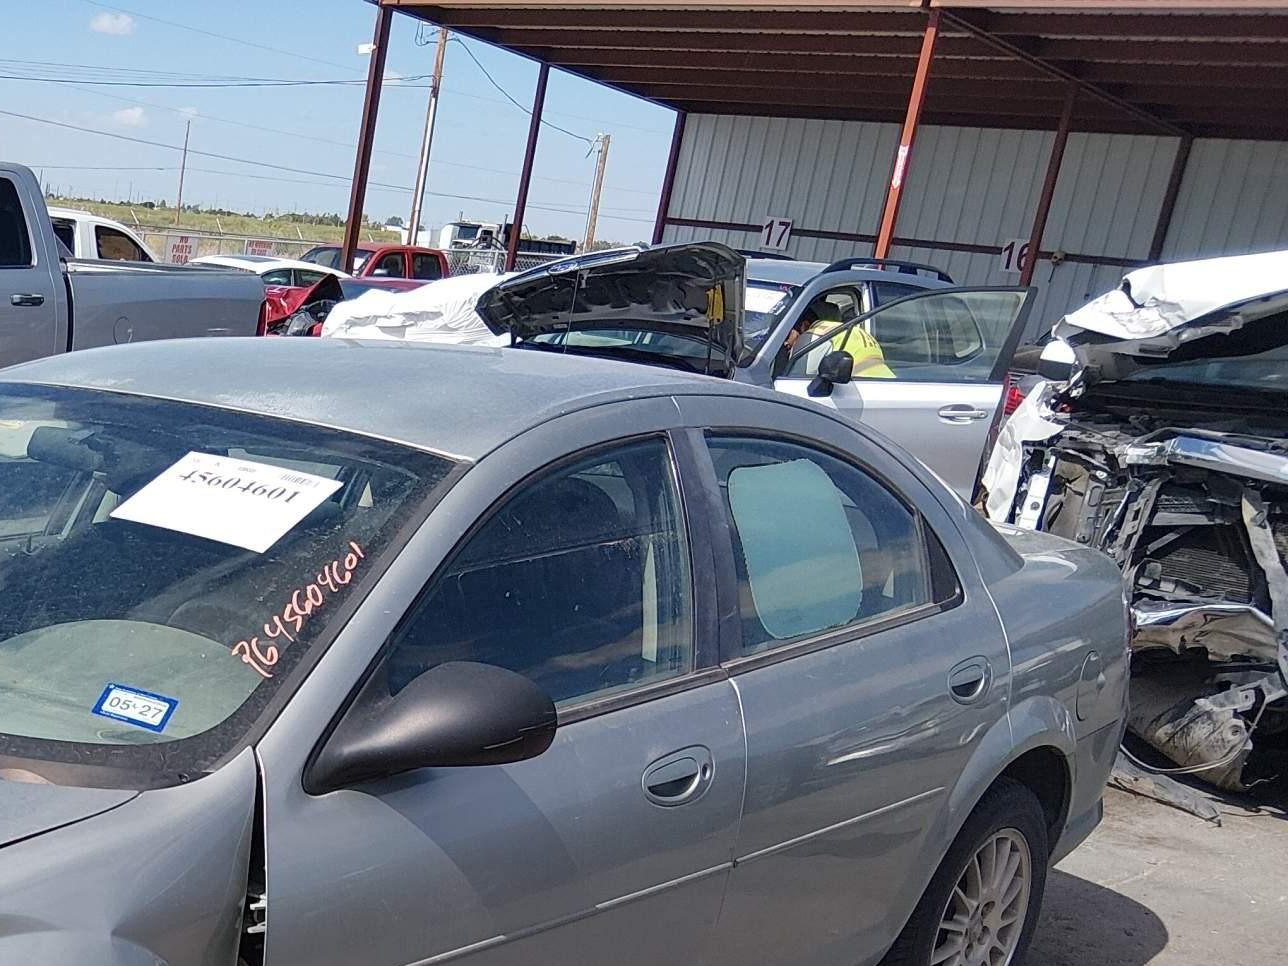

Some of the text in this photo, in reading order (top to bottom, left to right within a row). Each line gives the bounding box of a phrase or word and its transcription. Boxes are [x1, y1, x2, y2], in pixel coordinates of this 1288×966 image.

[765, 219, 791, 247] 17
[172, 244, 192, 254] PARTS
[179, 470, 300, 503] 45604601
